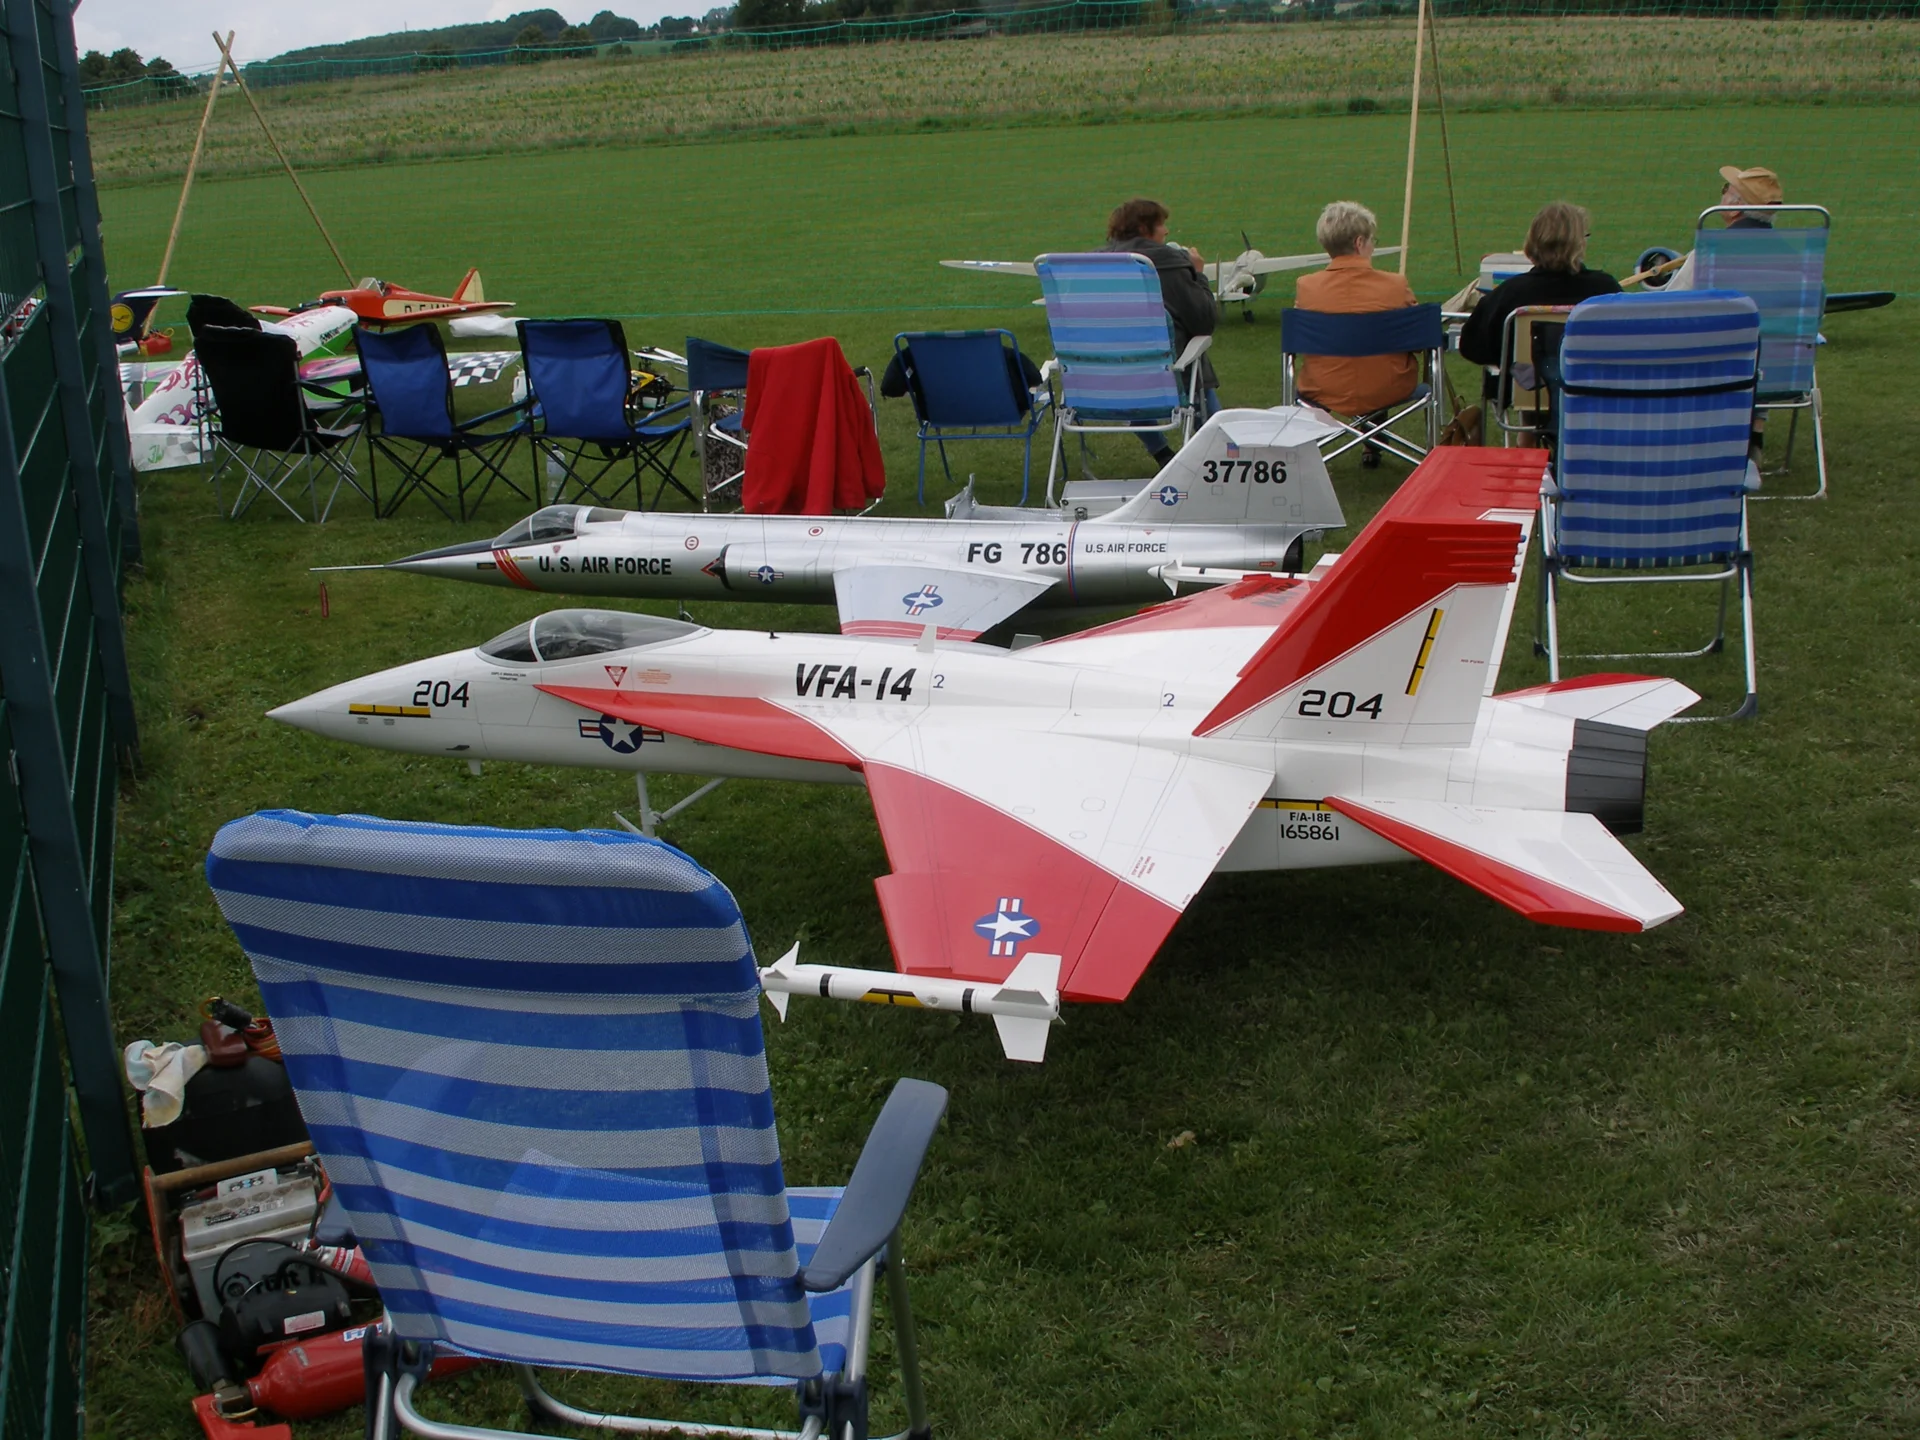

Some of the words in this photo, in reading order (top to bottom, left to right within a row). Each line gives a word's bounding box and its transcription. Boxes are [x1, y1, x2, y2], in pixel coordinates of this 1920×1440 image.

[1203, 460, 1287, 484] 37786
[967, 543, 1002, 564] FG
[1020, 543, 1067, 565] 786
[1127, 543, 1166, 553] FORCE
[538, 556, 555, 573] U.
[559, 557, 576, 574] S.
[580, 557, 610, 574] AIR
[614, 557, 672, 575] FORCE
[796, 663, 917, 702] VFA-14
[932, 674, 945, 689] 2
[413, 680, 470, 708] 204
[1162, 693, 1175, 707] 2
[1298, 689, 1383, 719] 204
[1289, 812, 1331, 823] F/A-18E
[1280, 824, 1339, 841] 165861
